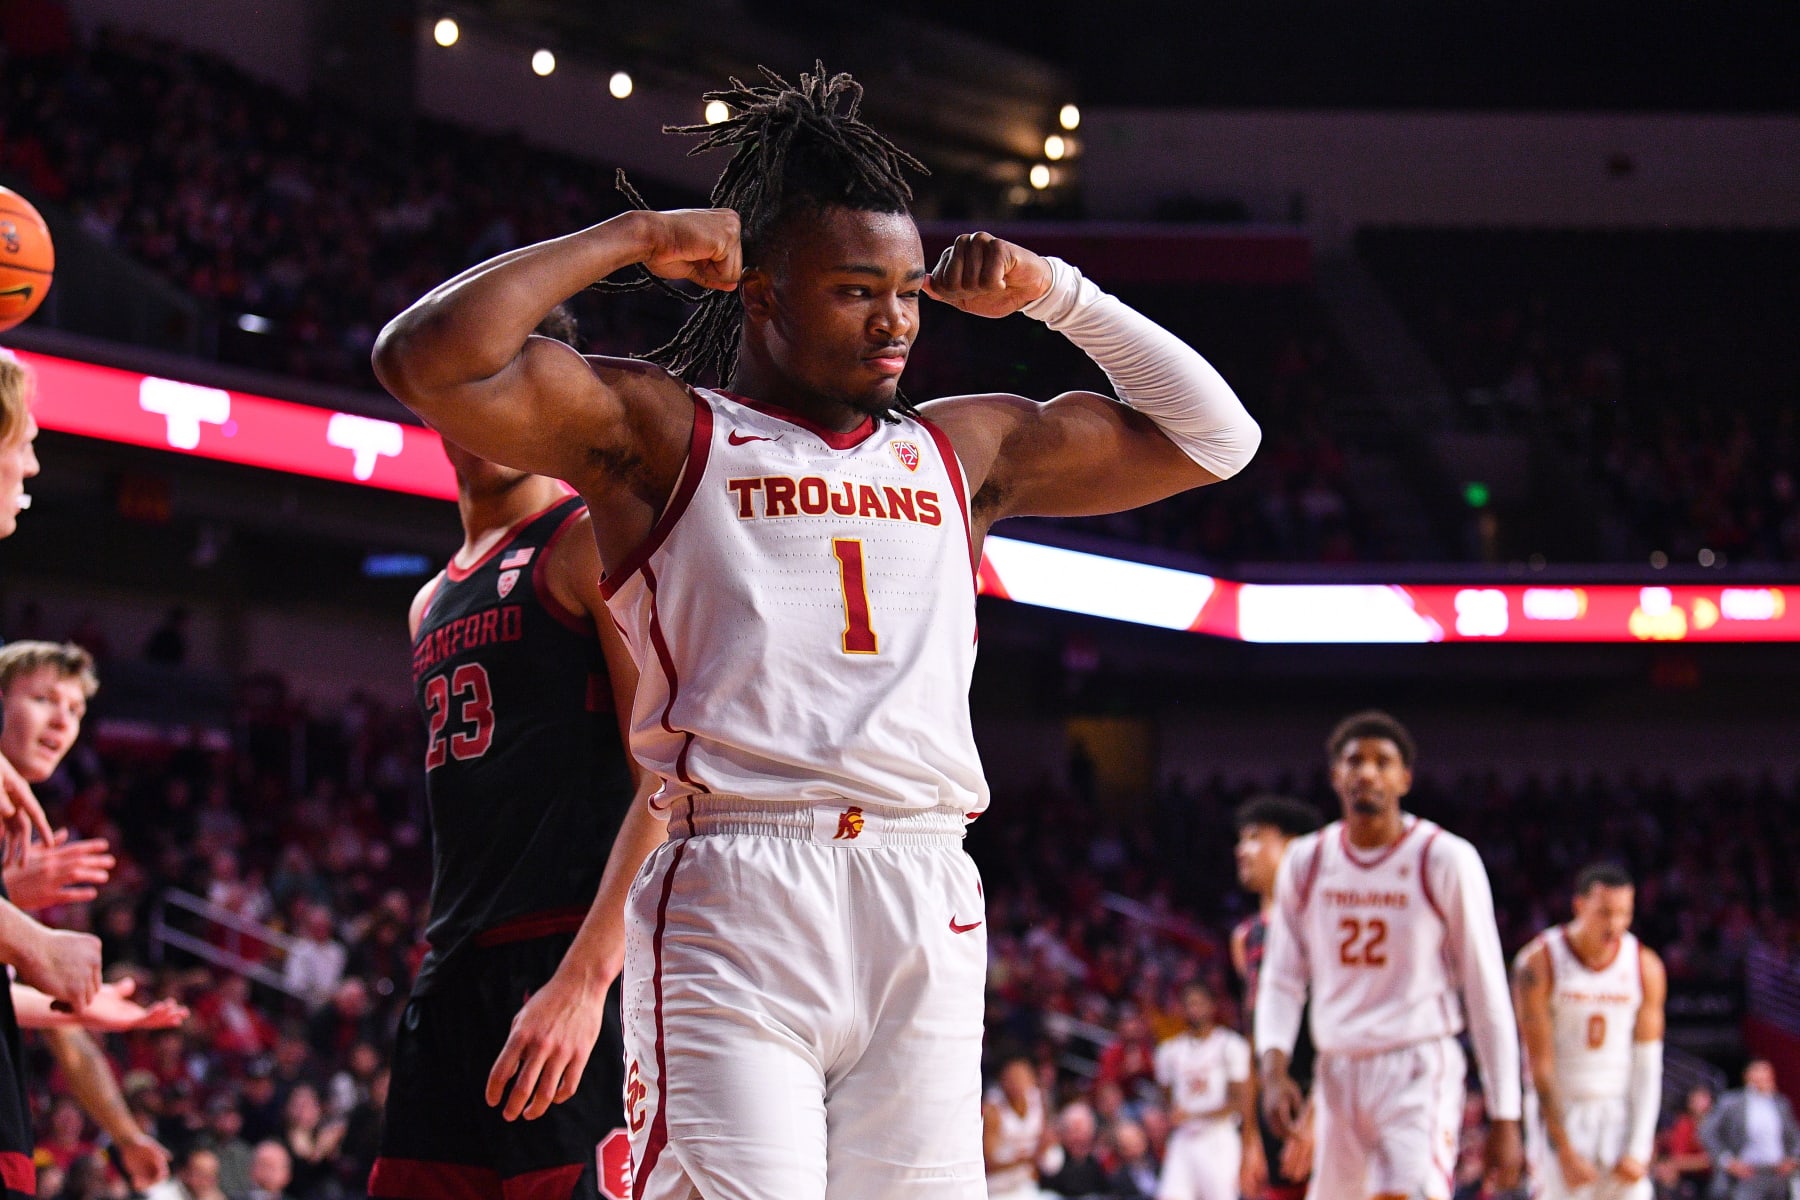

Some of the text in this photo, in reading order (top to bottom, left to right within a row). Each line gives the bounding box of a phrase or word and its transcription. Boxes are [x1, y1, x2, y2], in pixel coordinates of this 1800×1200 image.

[901, 453, 916, 466] 12
[727, 474, 943, 527] TROJANS
[831, 537, 879, 654] 1
[425, 662, 496, 773] 23
[1339, 916, 1388, 968] 22
[1587, 1012, 1607, 1050] 0
